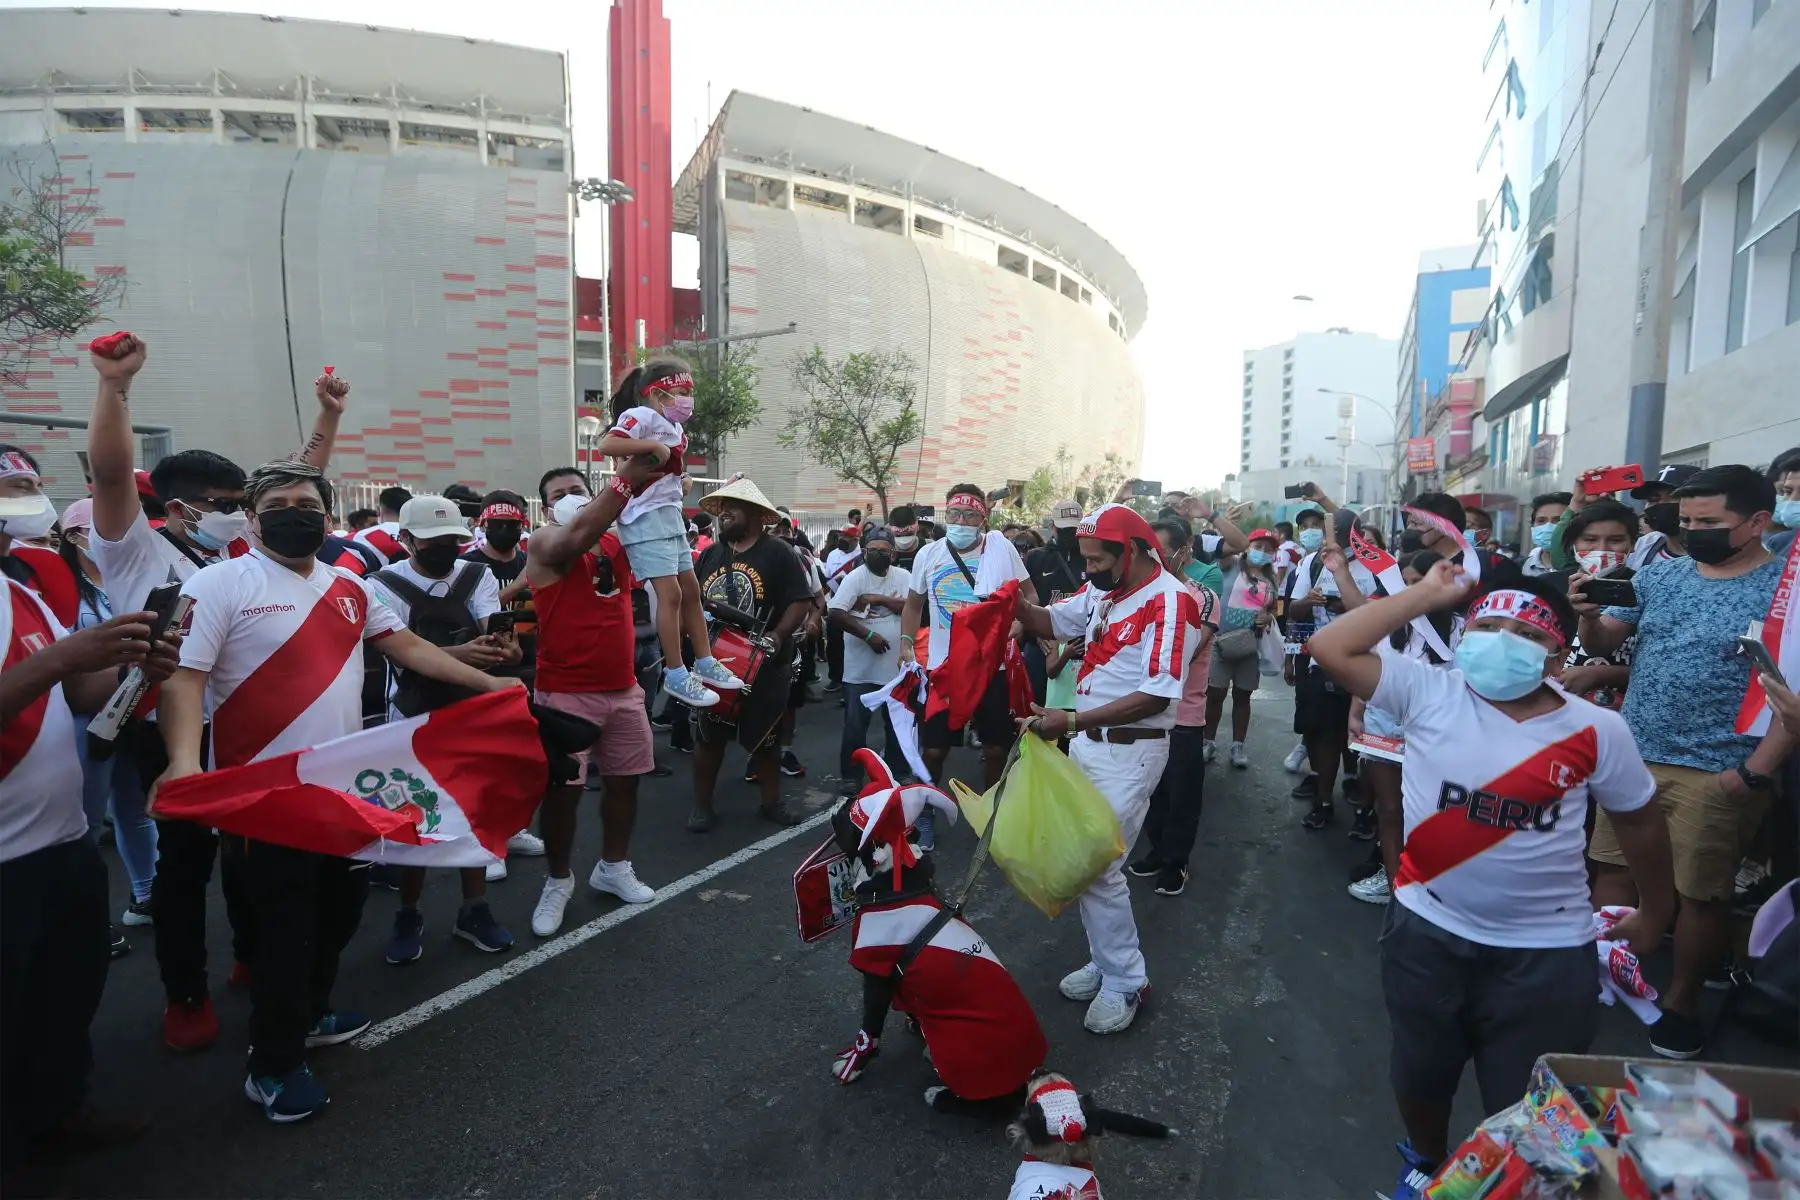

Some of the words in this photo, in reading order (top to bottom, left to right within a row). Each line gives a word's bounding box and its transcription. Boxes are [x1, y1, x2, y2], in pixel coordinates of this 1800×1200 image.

[747, 567, 764, 600] OUTAGE
[241, 603, 296, 617] marathon
[1436, 779, 1562, 833] PERU
